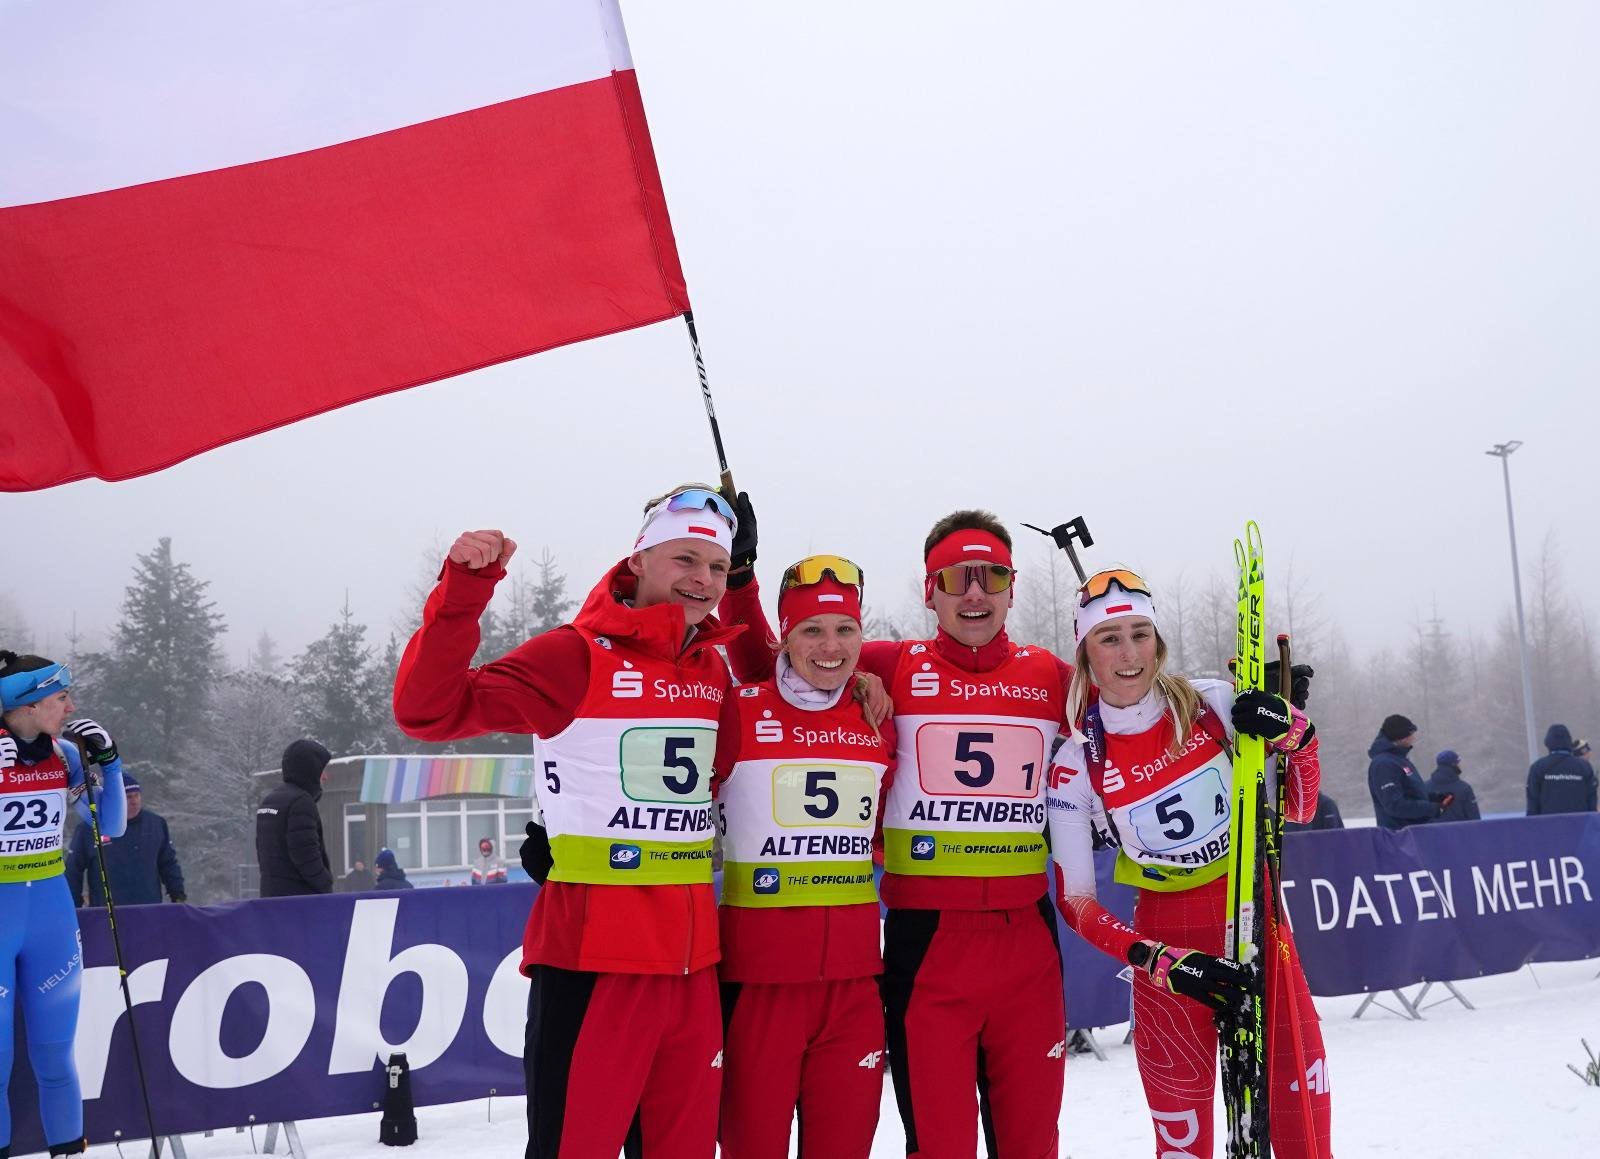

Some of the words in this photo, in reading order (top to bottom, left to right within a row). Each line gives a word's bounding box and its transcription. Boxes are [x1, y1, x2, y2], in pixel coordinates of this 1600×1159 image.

[950, 679, 1049, 702] Sparkasse
[793, 727, 880, 748] Sparkasse
[662, 737, 700, 795] 5
[954, 732, 995, 788] 5
[1022, 762, 1035, 791] 1
[9, 768, 65, 785] Sparkasse
[543, 761, 561, 795] 5
[803, 771, 839, 819] 5
[859, 796, 872, 821] 3
[3, 799, 48, 832] 23
[51, 811, 60, 826] 4
[909, 800, 1044, 824] ALTENBERG
[1155, 793, 1195, 841] 5
[1214, 793, 1225, 817] 4
[649, 852, 669, 860] THE
[671, 851, 705, 860] OFFICIAL
[760, 835, 873, 856] ALTENBER
[942, 845, 961, 853] THE
[964, 845, 1011, 854] OFFICIAL
[17, 860, 47, 870] OFFICIAL
[788, 876, 808, 885] THE
[812, 874, 855, 885] OFFICIAL
[1311, 869, 1457, 931] DATEN
[1471, 856, 1593, 916] MEHR
[38, 953, 80, 994] HELLAS
[711, 1050, 723, 1069] 4
[859, 1050, 882, 1069] 4F
